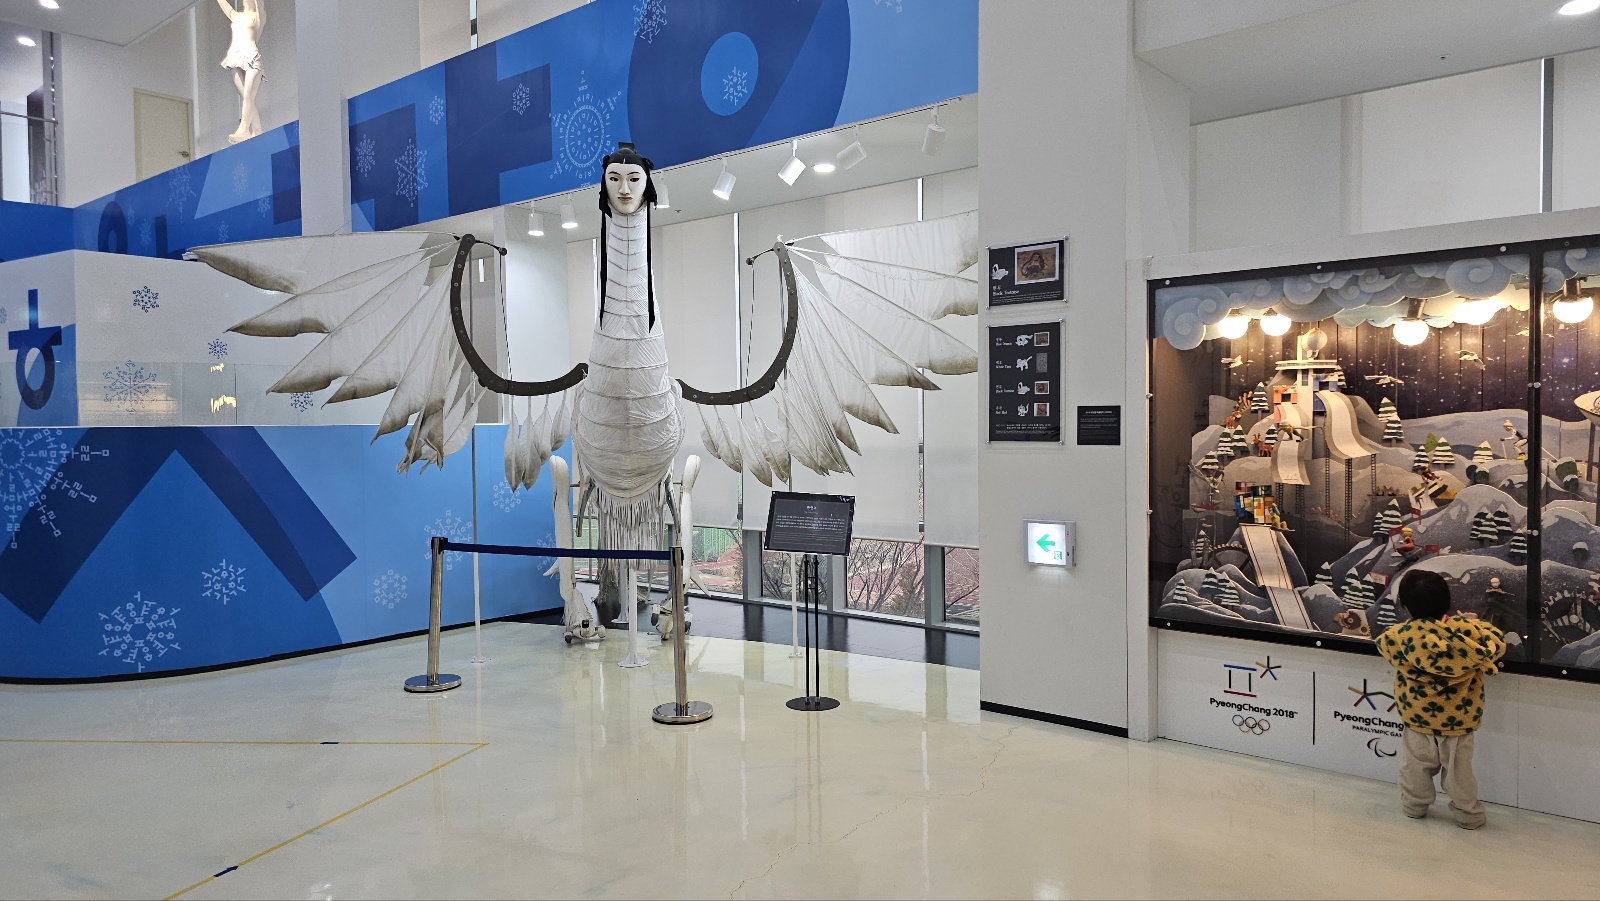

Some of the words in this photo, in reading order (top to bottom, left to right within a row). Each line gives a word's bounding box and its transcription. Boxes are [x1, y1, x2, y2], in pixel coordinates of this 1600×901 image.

[1210, 697, 1272, 717] PyeongChang
[1333, 710, 1405, 732] PyeongChang
[1352, 725, 1390, 736] PARALYMPIC
